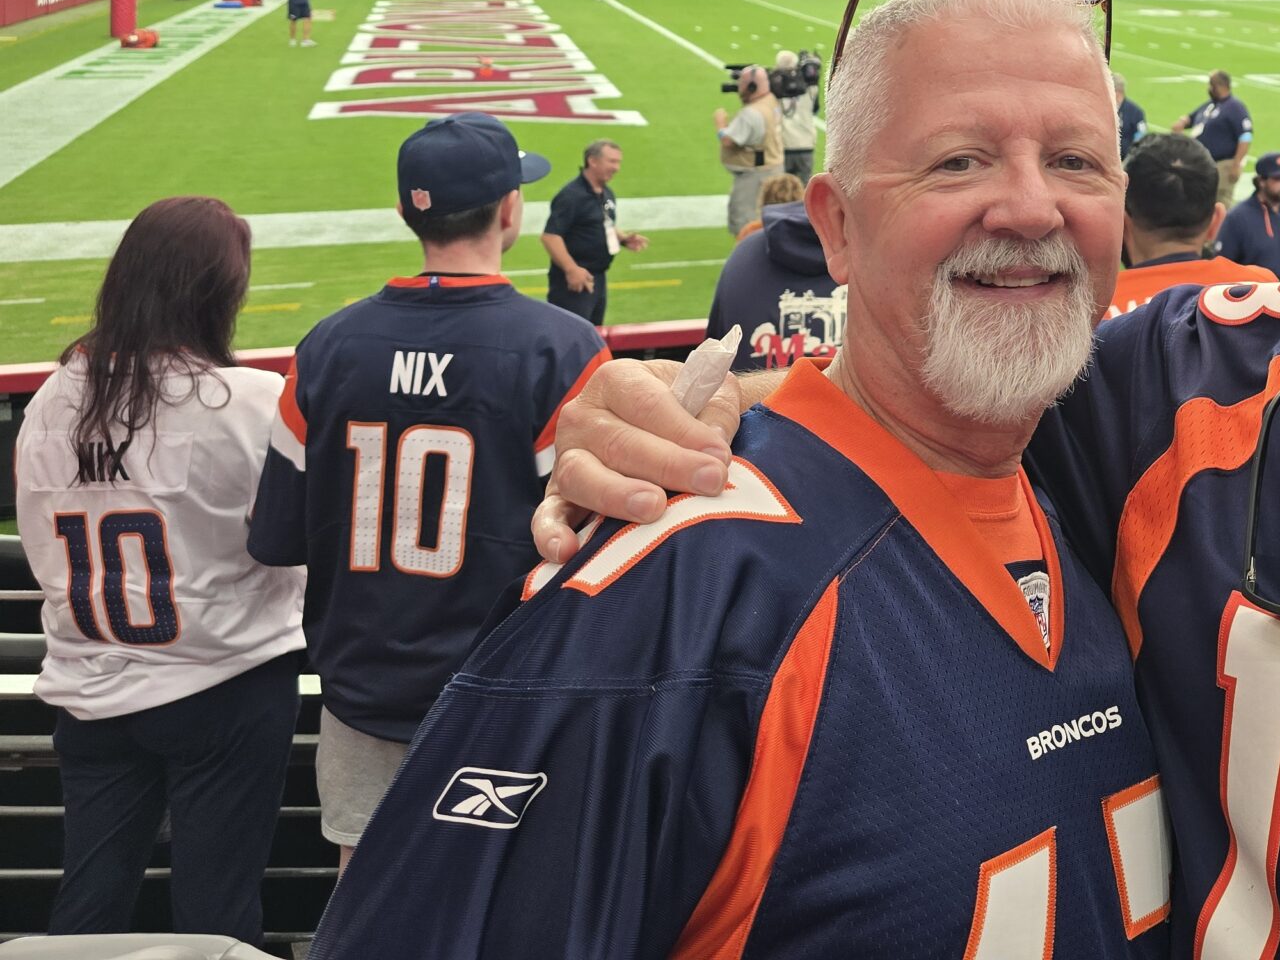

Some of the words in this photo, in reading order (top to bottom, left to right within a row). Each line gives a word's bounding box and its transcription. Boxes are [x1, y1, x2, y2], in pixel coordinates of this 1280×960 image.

[389, 350, 455, 397] NIX
[347, 421, 475, 579] 10
[54, 509, 182, 646] 10
[1026, 705, 1122, 760] BRONCOS
